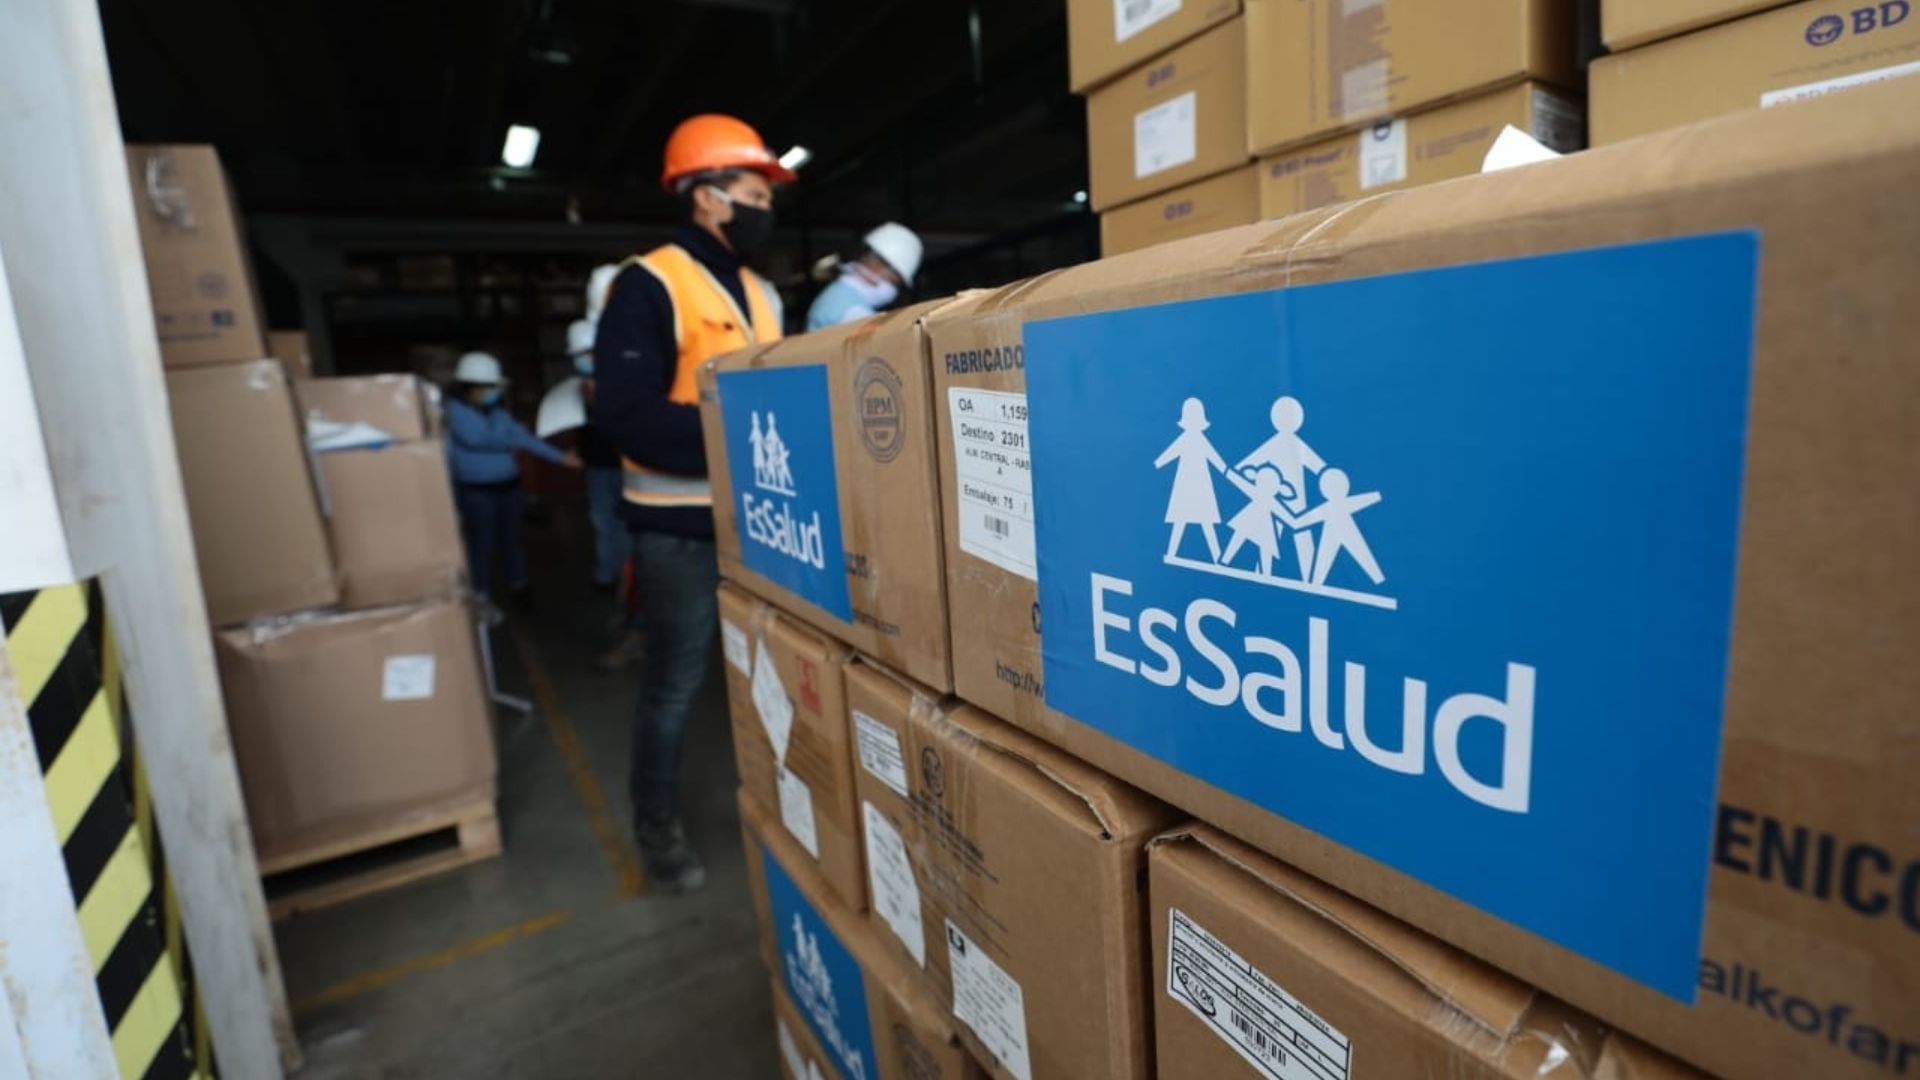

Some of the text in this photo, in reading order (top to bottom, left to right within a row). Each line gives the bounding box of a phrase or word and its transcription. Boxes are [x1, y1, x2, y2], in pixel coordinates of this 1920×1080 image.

[1851, 0, 1910, 35] BD
[945, 343, 1024, 375] FABRICADO
[958, 397, 974, 413] OA
[961, 422, 1025, 448] Destino 2301
[742, 492, 825, 570] EsSalud
[1091, 572, 1537, 814] EsSalud
